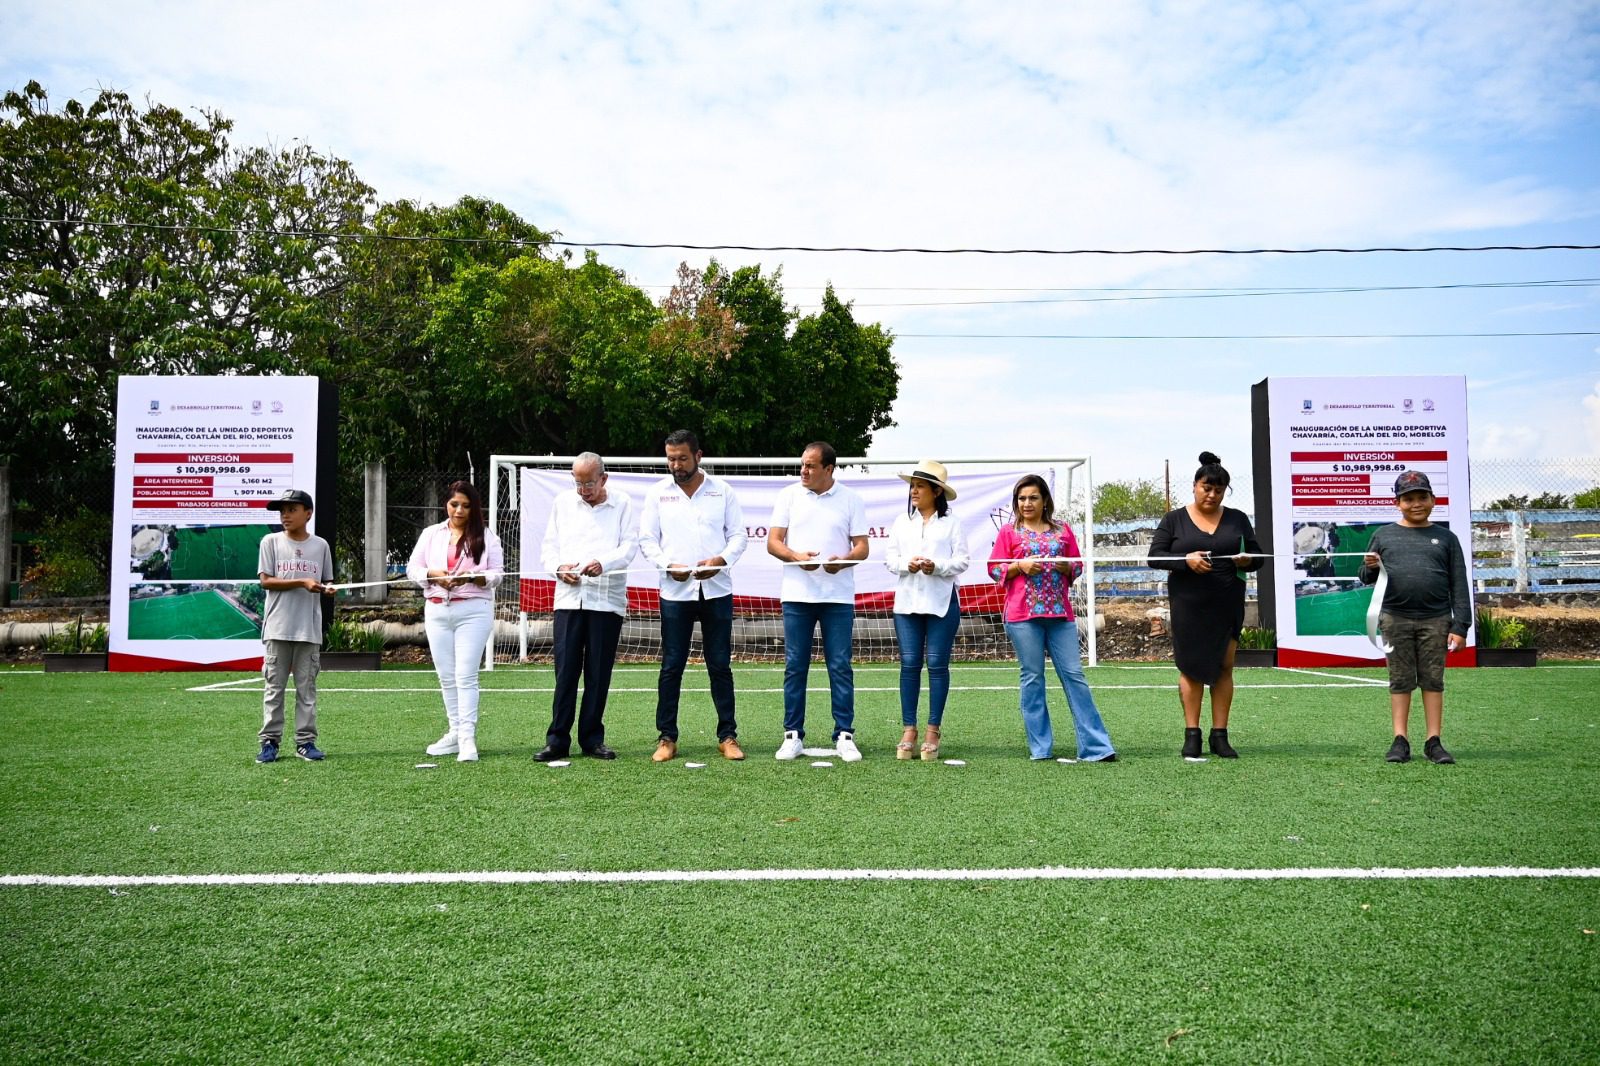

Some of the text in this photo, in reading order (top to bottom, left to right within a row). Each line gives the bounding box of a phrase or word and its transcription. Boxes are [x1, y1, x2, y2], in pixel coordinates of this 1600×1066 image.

[188, 454, 240, 462] INVERSIÓN
[1344, 452, 1394, 460] INVERSIÓN
[176, 466, 250, 474] $ 10,989,998.69
[1333, 464, 1338, 472] $
